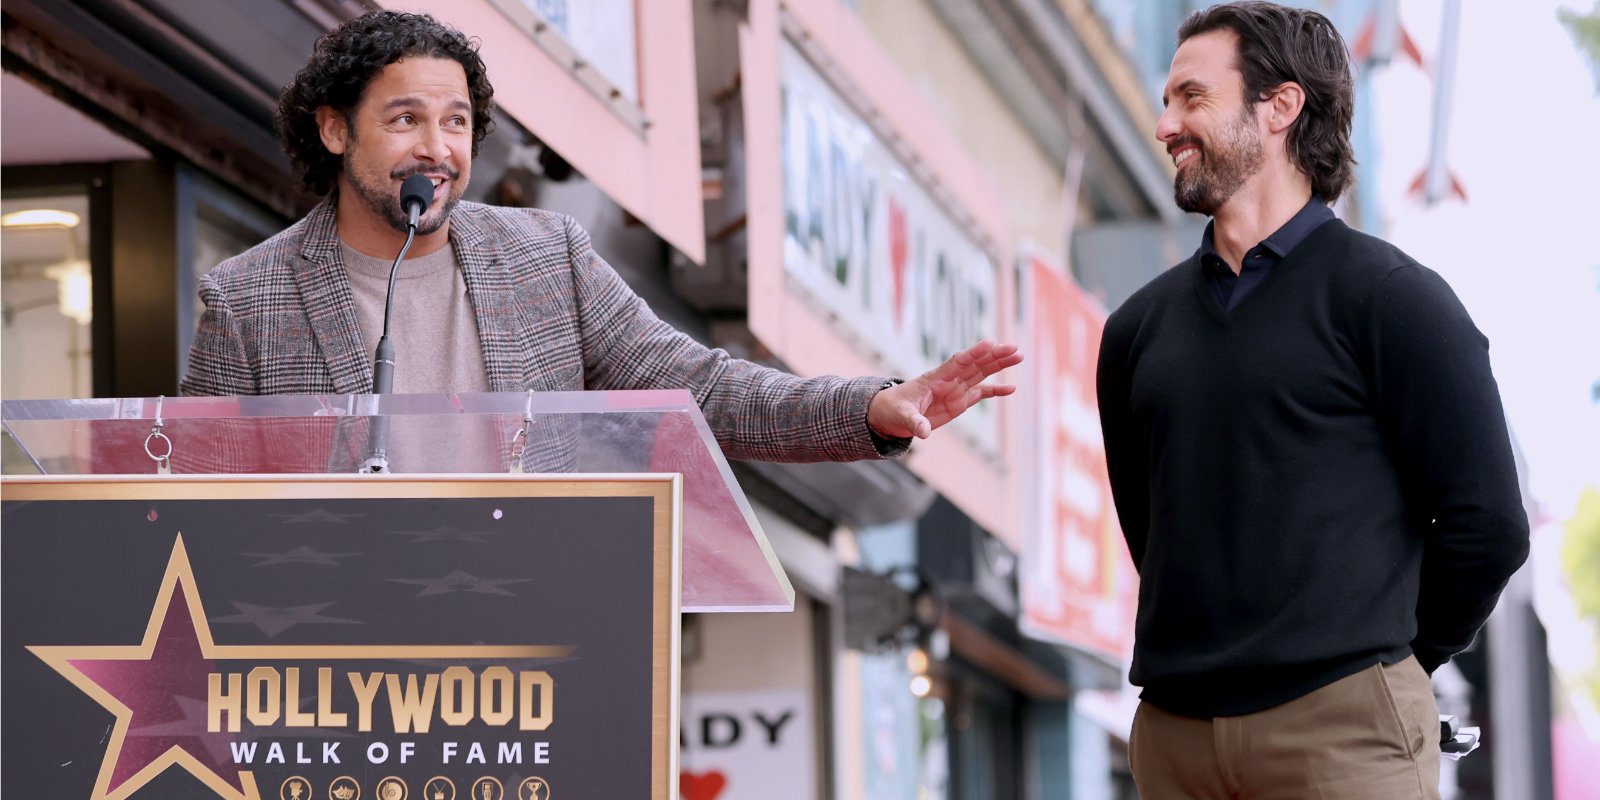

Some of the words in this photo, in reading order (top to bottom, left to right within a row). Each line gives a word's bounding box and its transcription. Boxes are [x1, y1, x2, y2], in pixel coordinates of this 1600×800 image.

[207, 666, 554, 733] HOLLYWOOD
[680, 709, 794, 749] DY
[230, 742, 341, 764] WALK
[366, 742, 415, 764] OF
[442, 742, 550, 764] FAME
